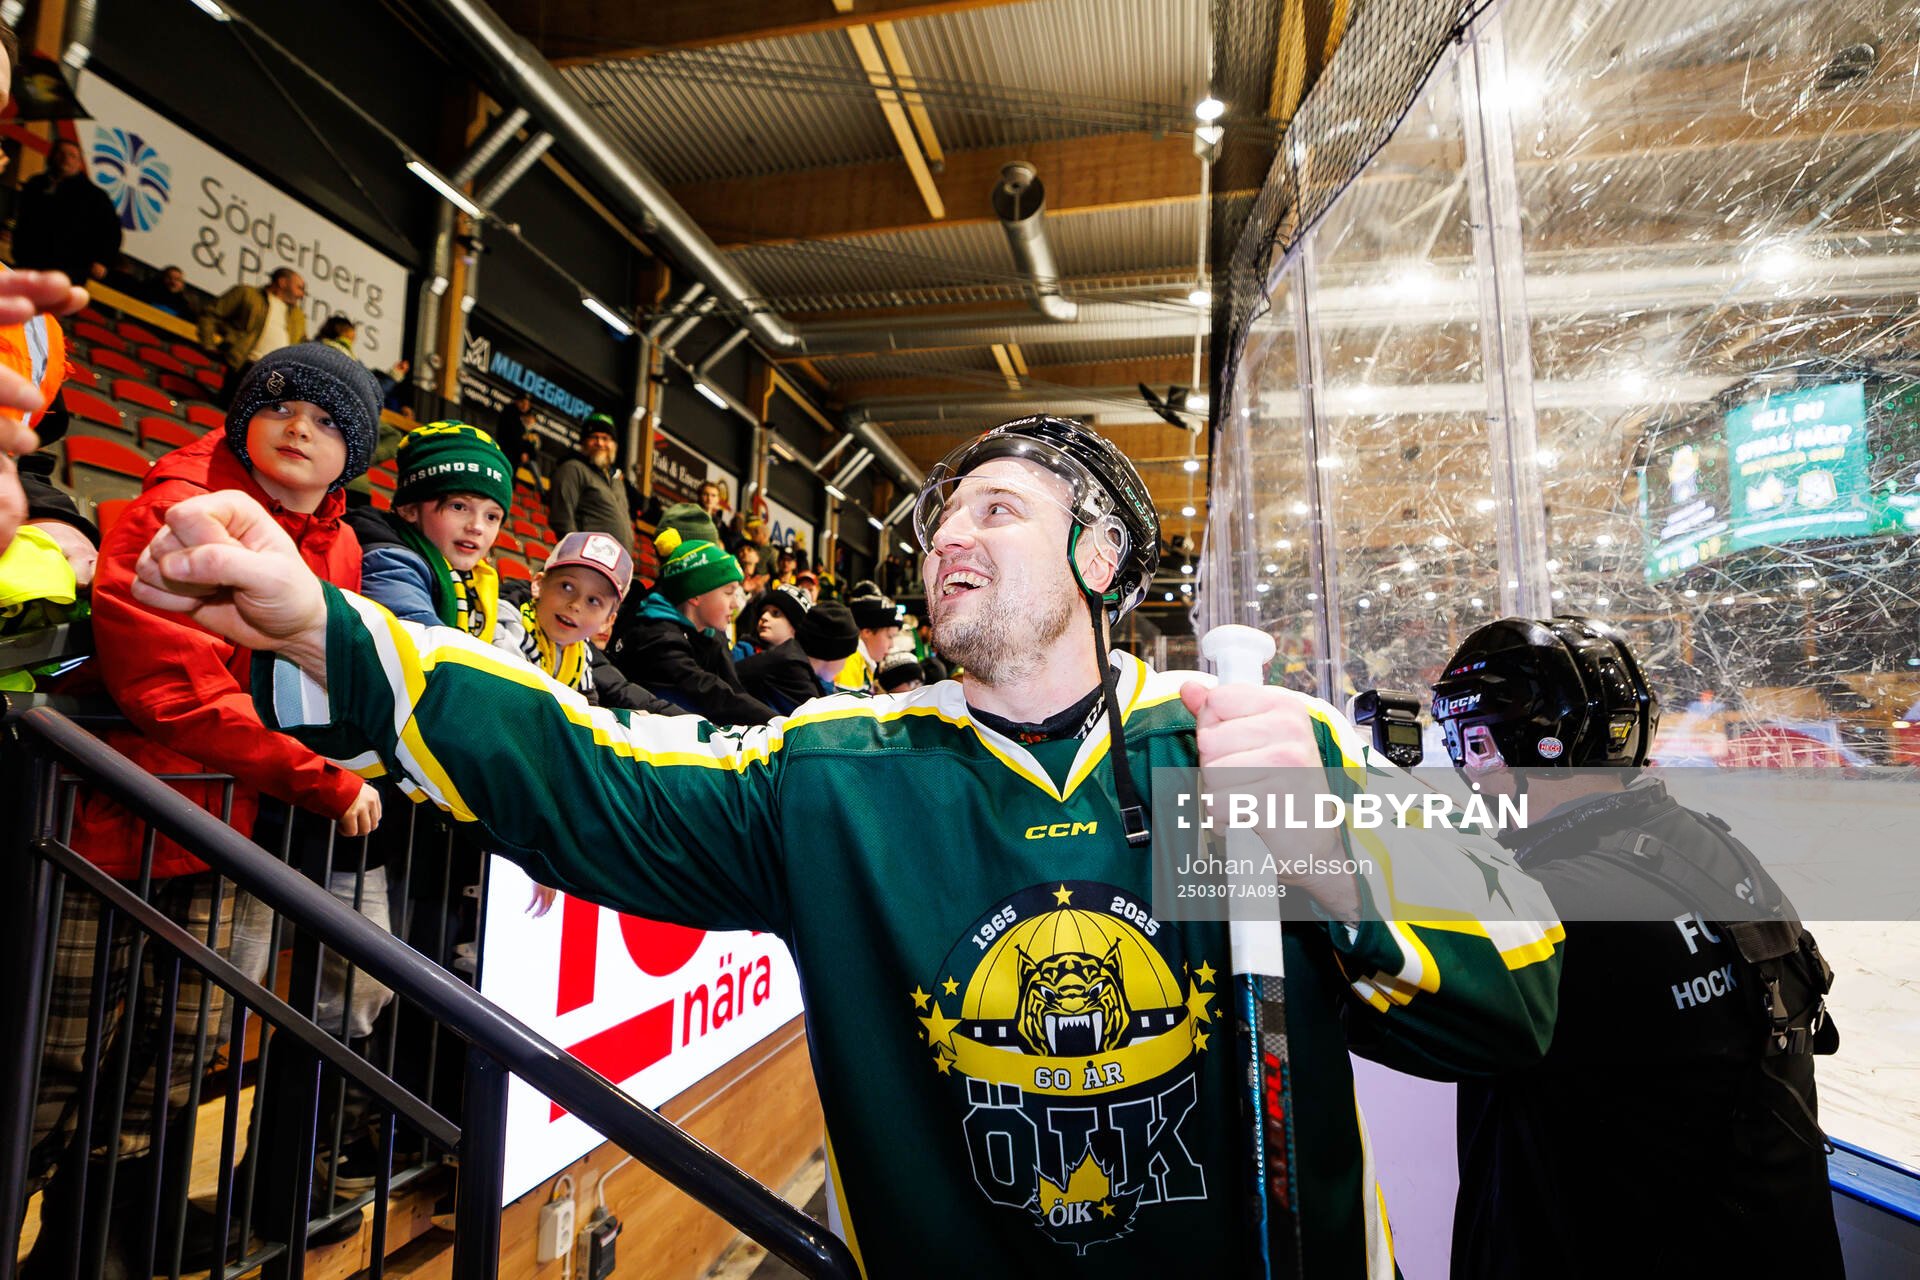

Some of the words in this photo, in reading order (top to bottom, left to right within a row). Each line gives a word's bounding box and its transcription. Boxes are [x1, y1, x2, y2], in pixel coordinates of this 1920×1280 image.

[191, 226, 227, 276] &
[198, 176, 384, 320] Söderberg
[486, 467, 503, 483] IK
[1449, 692, 1482, 710] CCM
[1024, 821, 1098, 840] CCM
[971, 904, 1018, 951] 1965
[1110, 895, 1161, 937] 2025
[682, 952, 771, 1048] nära
[1034, 1067, 1071, 1090] 60
[1083, 1060, 1125, 1090] ÅR
[962, 1072, 1208, 1209] ÖIK
[1047, 1199, 1093, 1226] ÖIK
